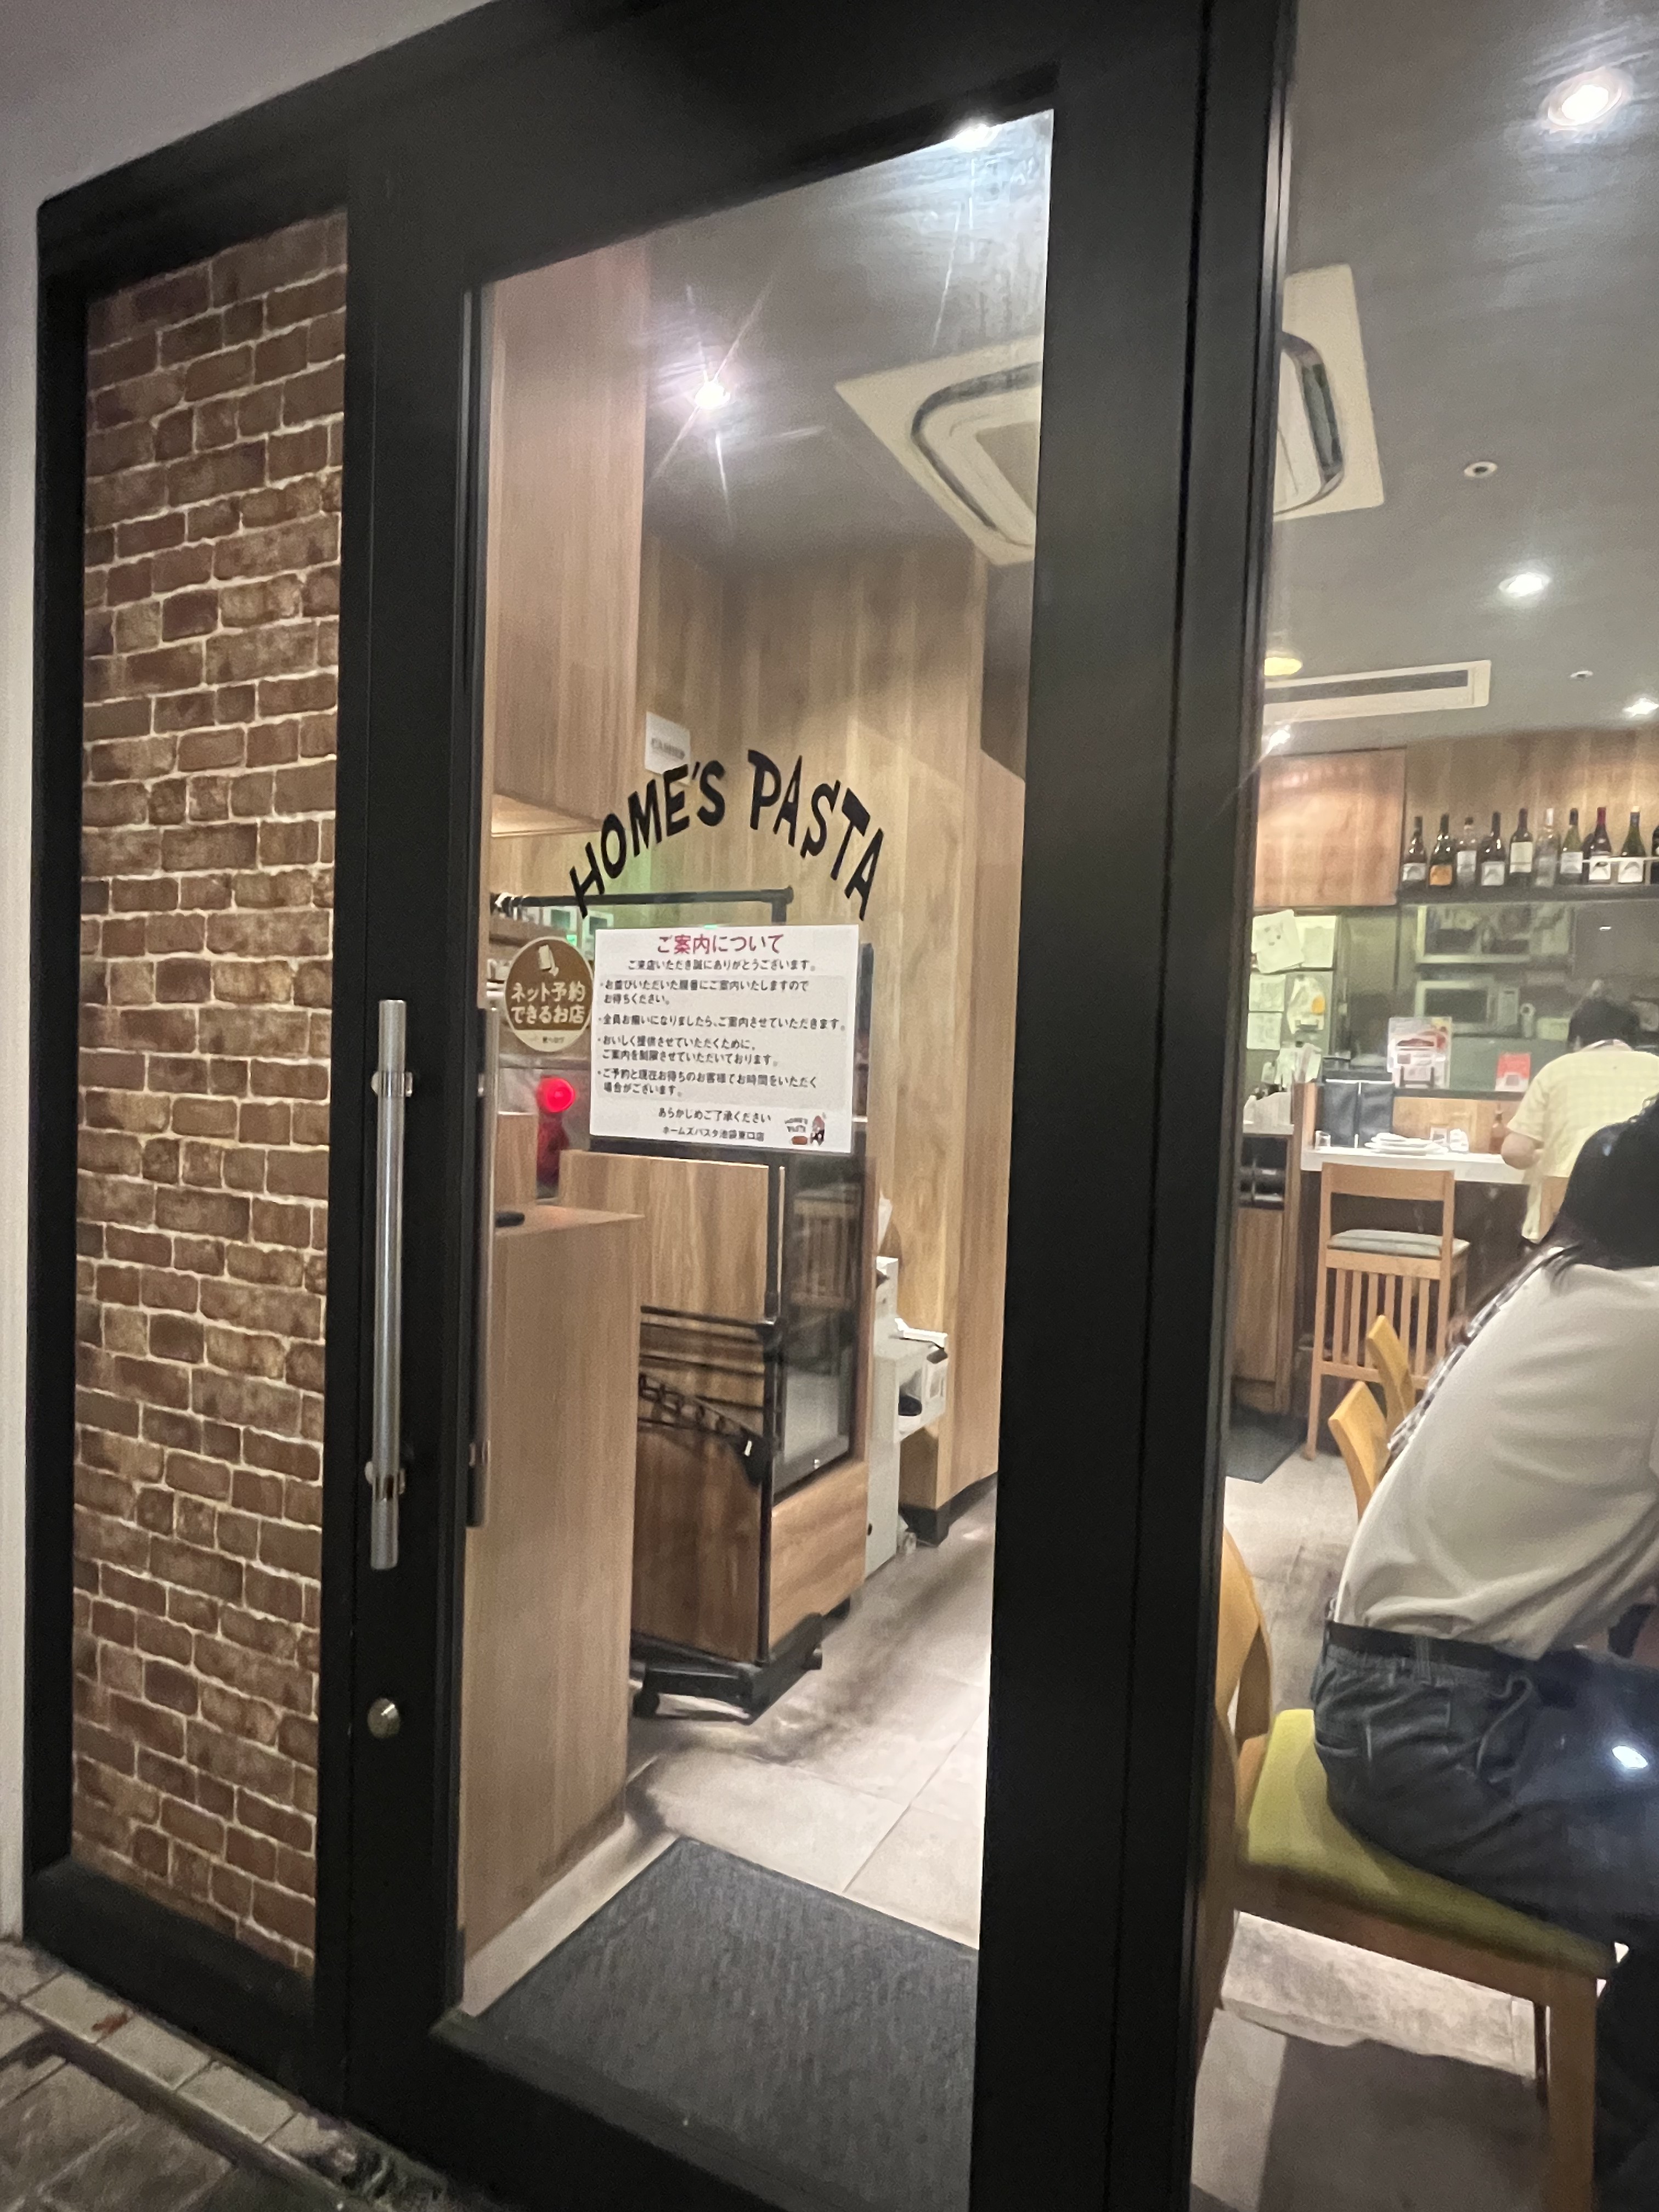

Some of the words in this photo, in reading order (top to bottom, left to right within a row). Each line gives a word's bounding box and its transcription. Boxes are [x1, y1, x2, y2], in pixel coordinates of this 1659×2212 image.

[569, 760, 726, 919] HOME'S
[747, 749, 884, 921] PASTA
[658, 934, 784, 955] ご案内について
[511, 980, 586, 1003] ネット予約
[511, 1004, 585, 1025] できるお店
[658, 1107, 771, 1123] あらかじめご了承ください
